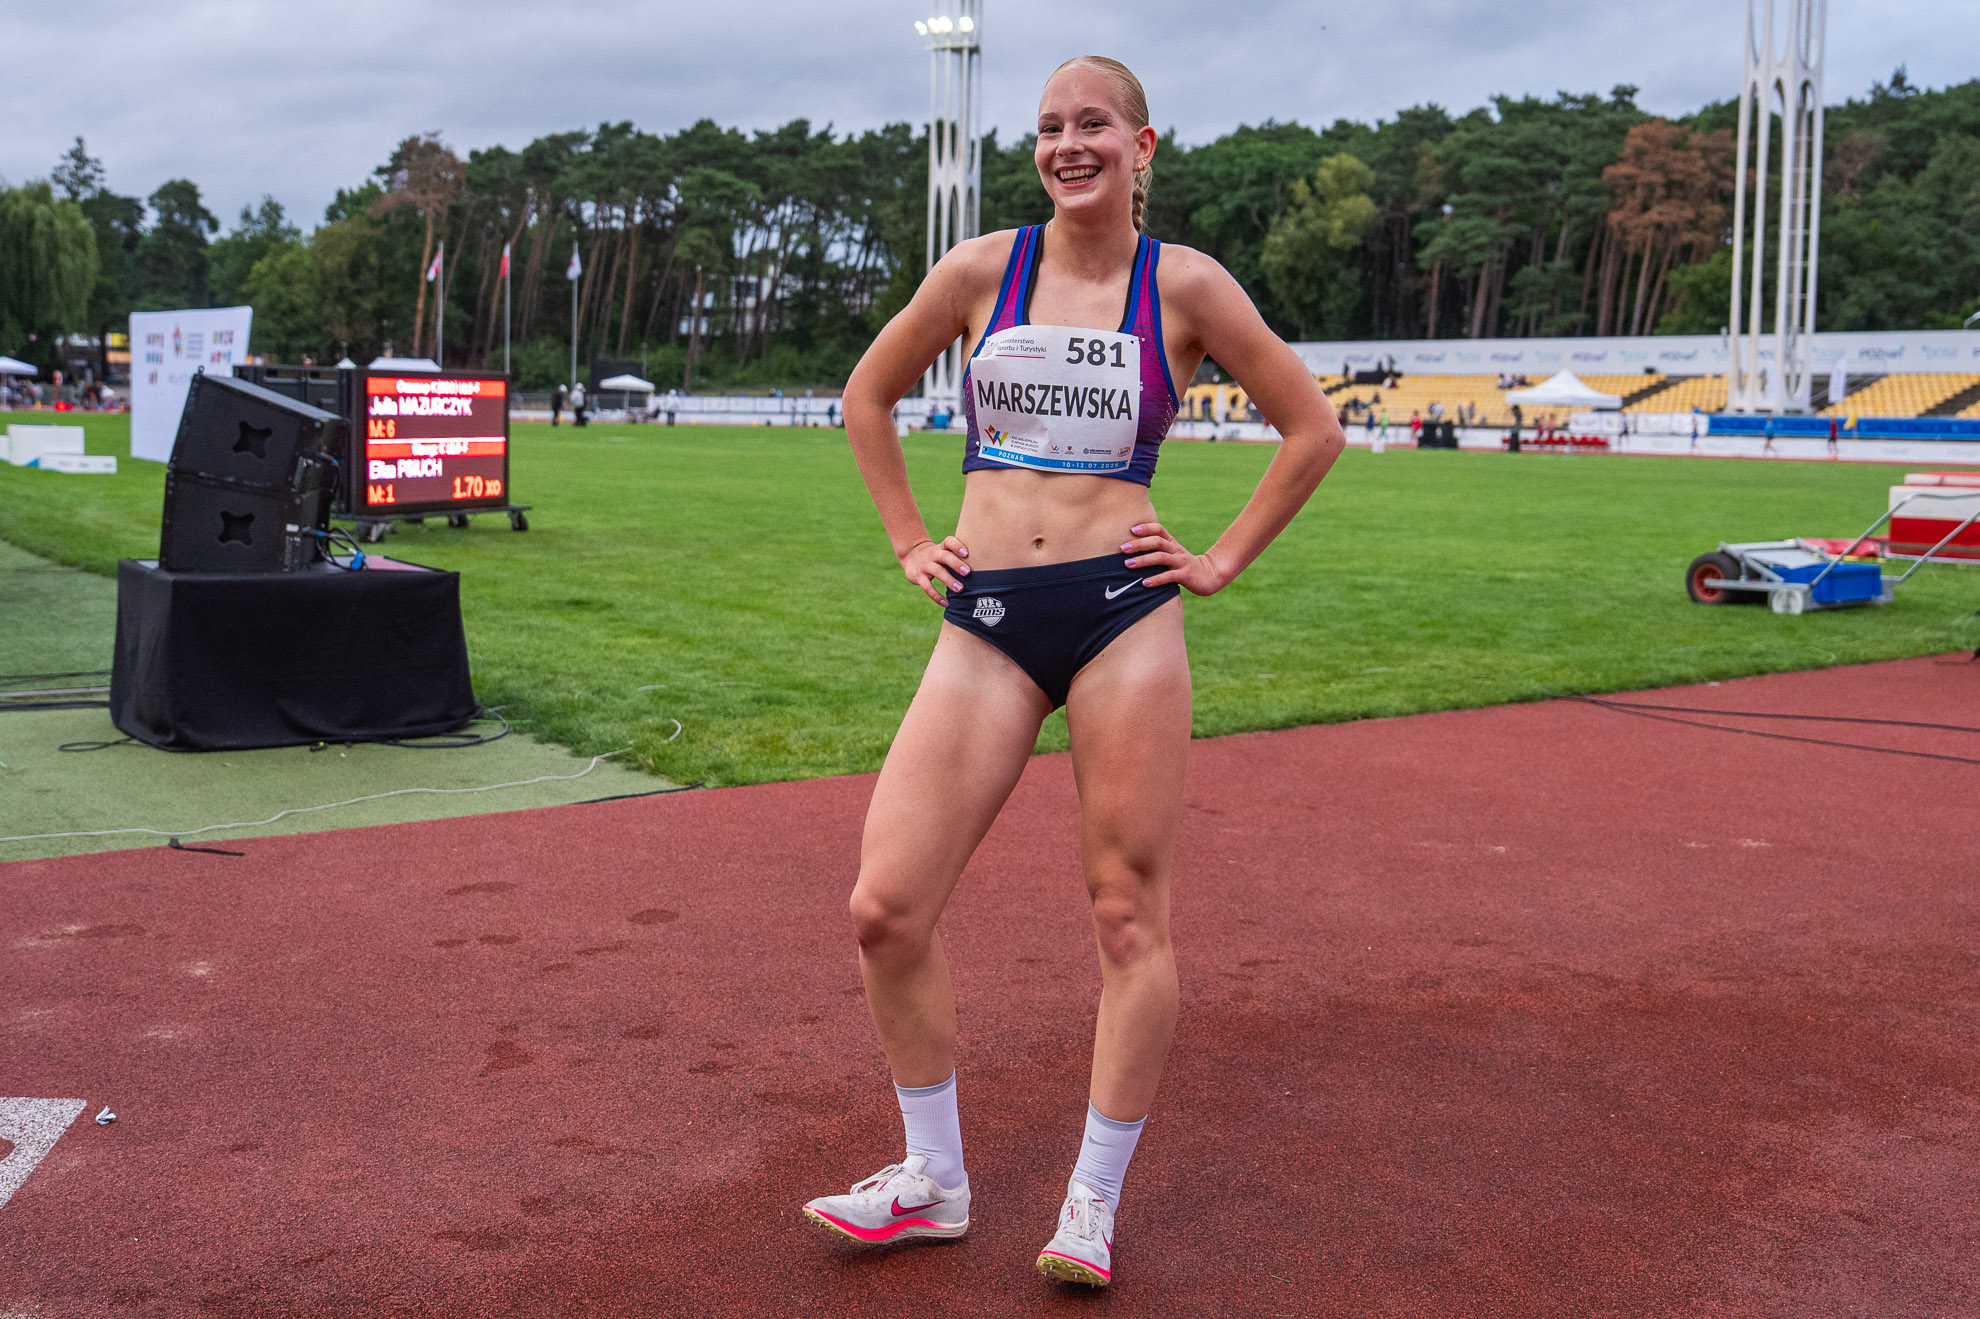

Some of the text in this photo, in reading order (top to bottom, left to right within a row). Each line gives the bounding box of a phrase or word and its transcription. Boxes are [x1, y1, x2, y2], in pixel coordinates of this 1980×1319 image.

[1020, 345, 1047, 353] Turystyki
[1065, 337, 1126, 368] 581
[977, 379, 1132, 421] MARSZEWSKA
[998, 451, 1025, 462] POZNAŃ
[452, 475, 484, 499] 1.70
